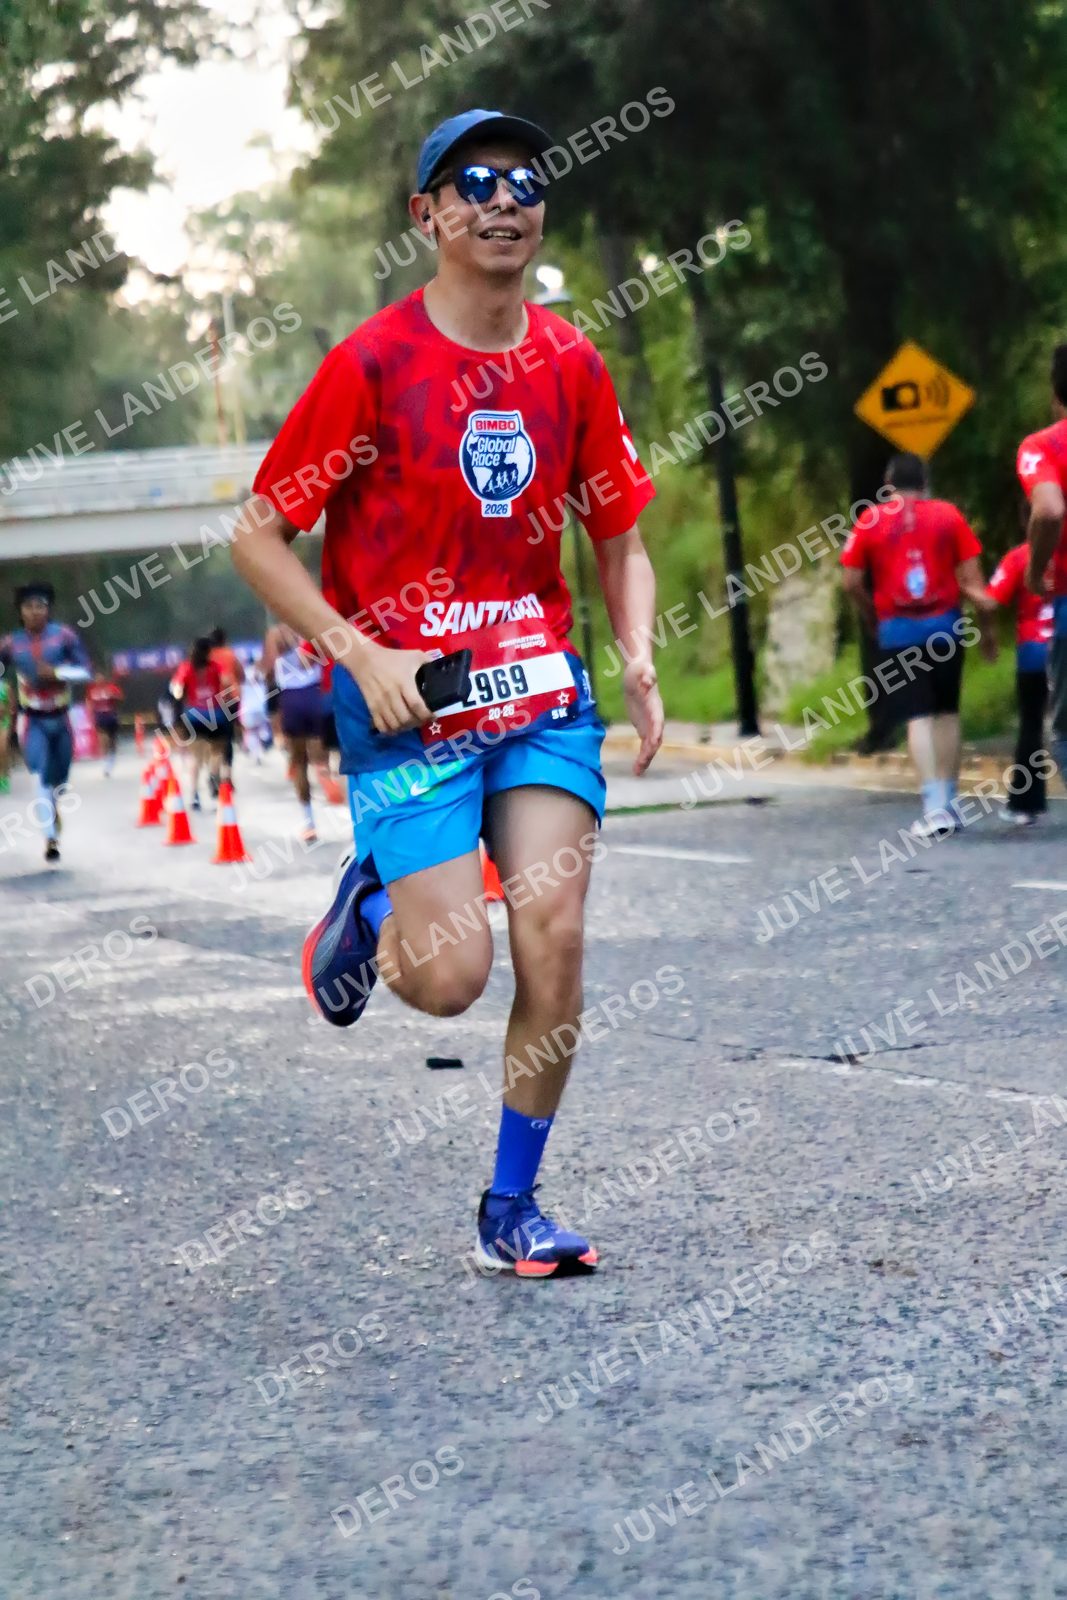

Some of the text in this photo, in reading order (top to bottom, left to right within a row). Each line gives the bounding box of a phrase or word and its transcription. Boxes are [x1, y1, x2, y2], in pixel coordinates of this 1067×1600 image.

[478, 437, 516, 453] Global
[471, 452, 500, 467] Race
[485, 503, 508, 515] 2026
